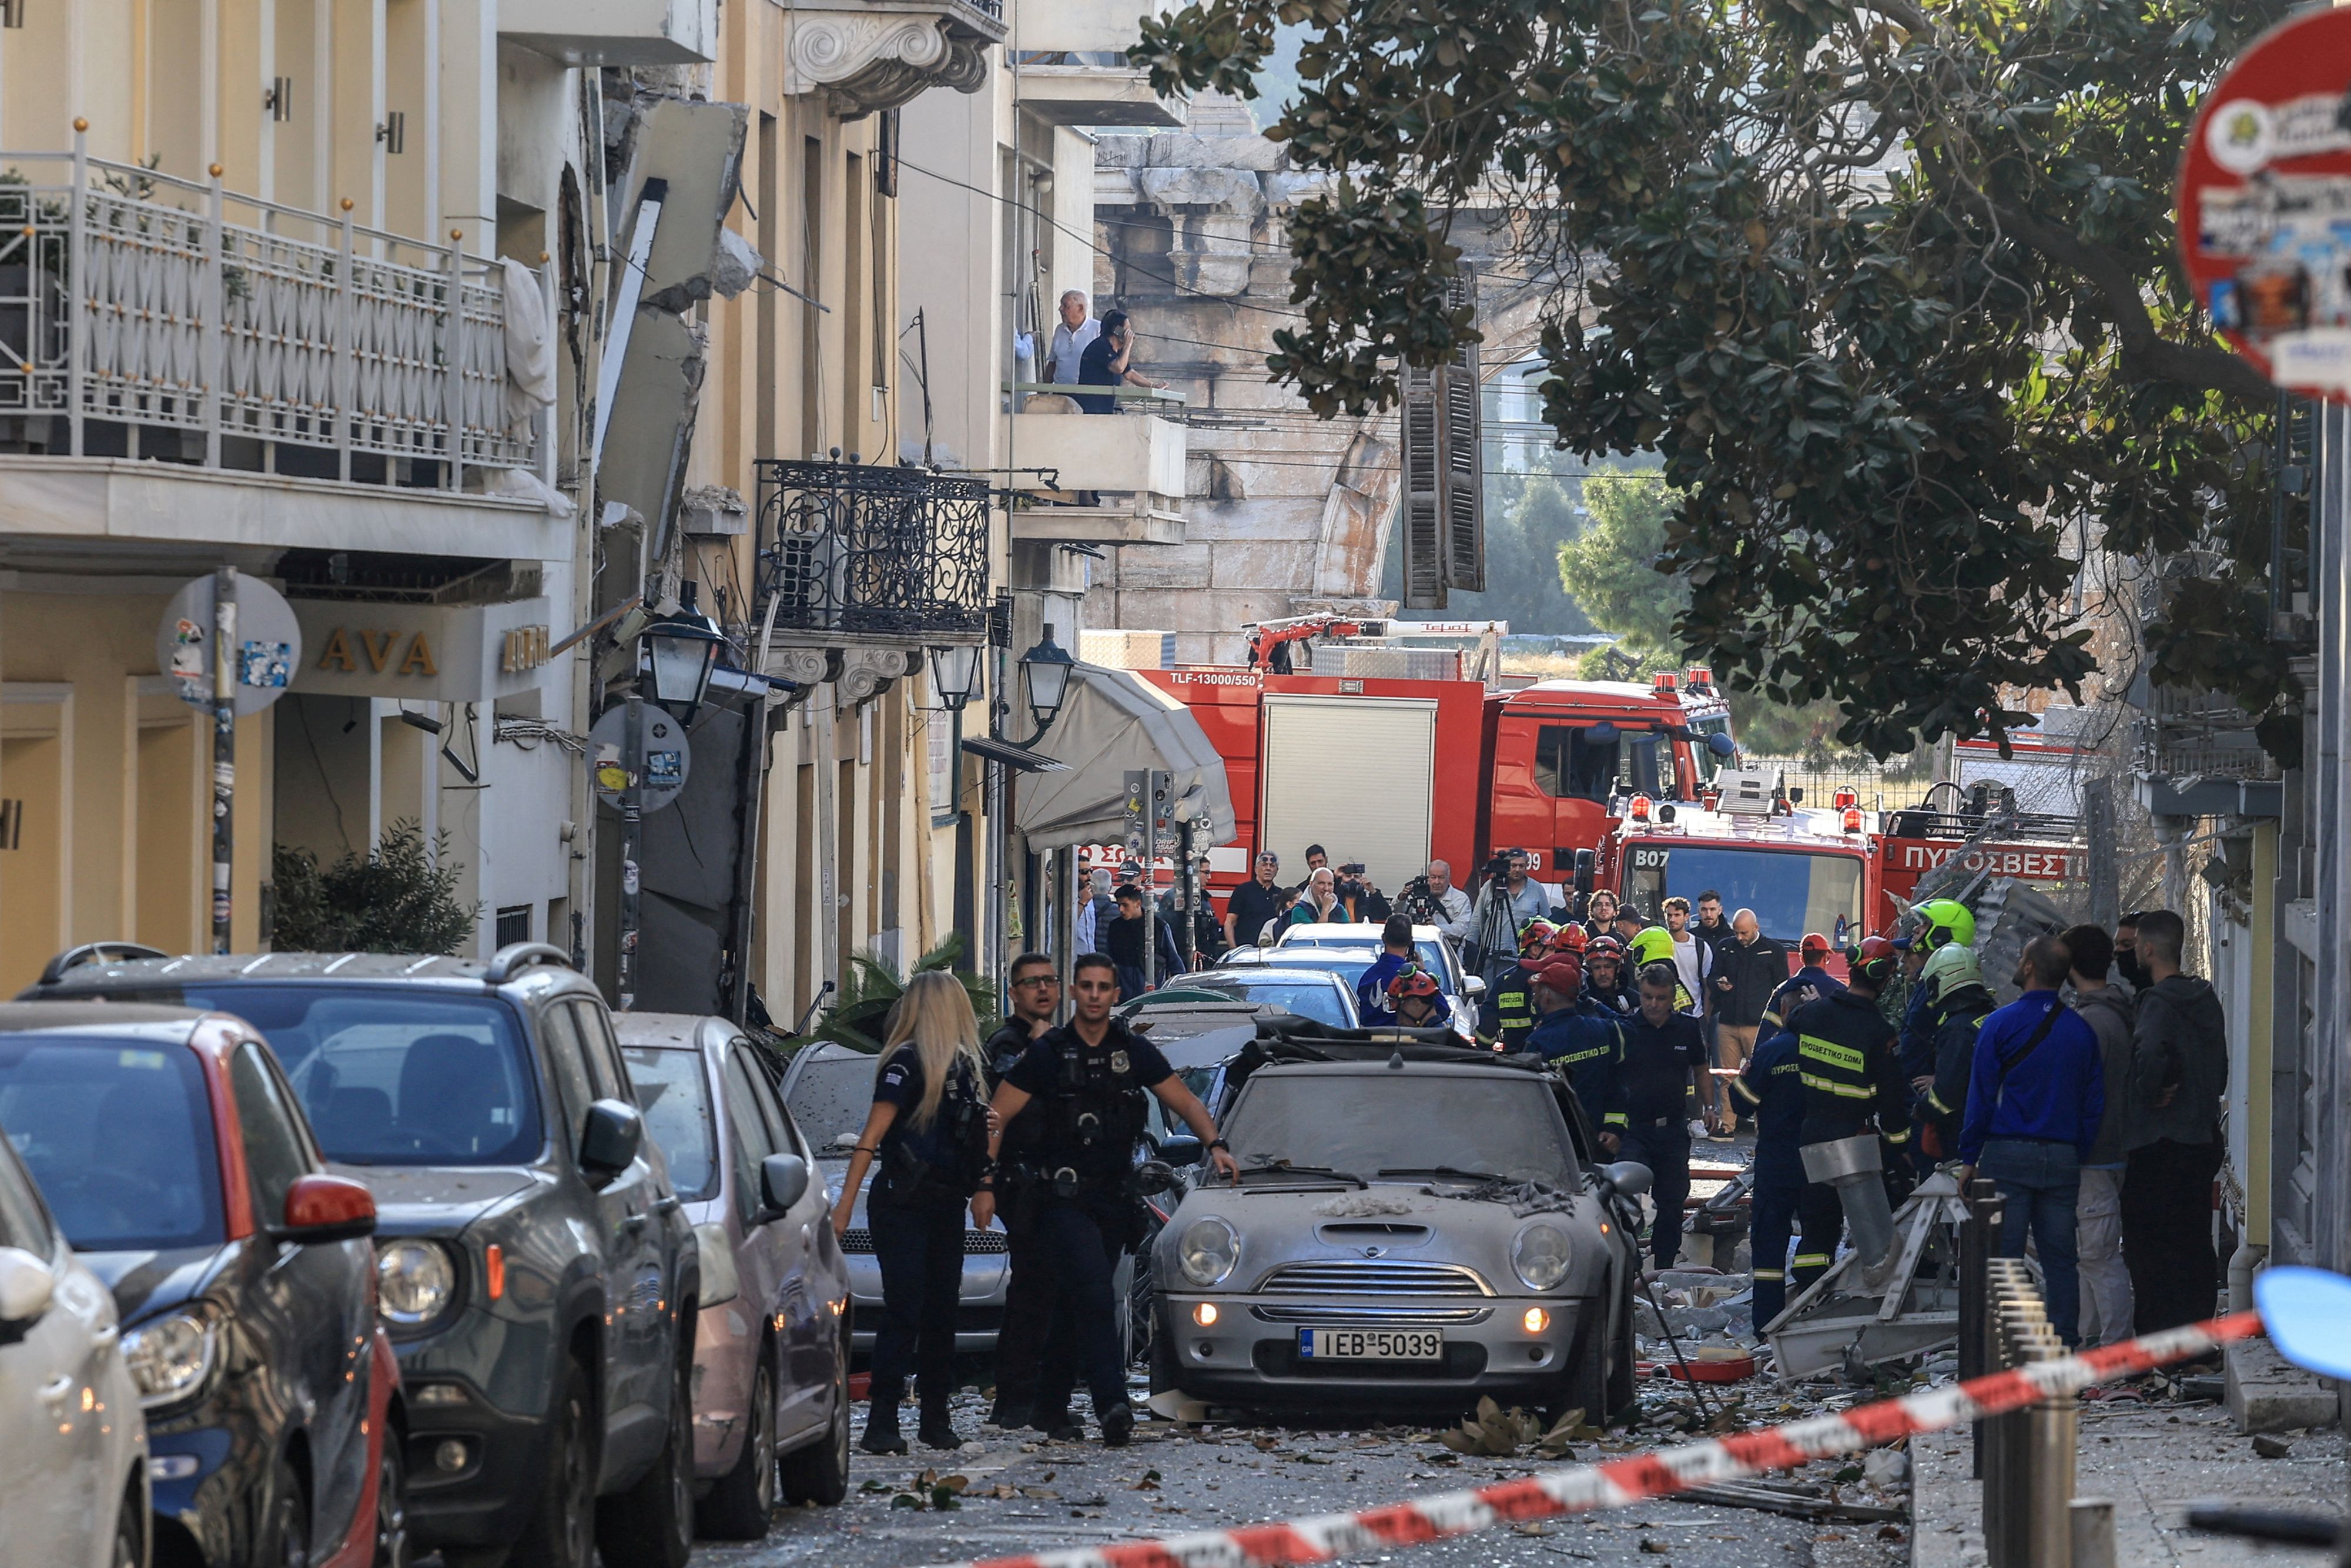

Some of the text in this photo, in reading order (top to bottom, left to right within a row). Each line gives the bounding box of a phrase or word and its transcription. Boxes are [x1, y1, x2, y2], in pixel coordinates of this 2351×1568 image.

[317, 626, 438, 675] AVA
[1170, 672, 1255, 686] TLF-13000/550
[1635, 850, 1670, 867] B07
[1905, 846, 2089, 877] ΠΥΟΣΒΕΣΤΙ
[1325, 1332, 1438, 1356] IEB-5039
